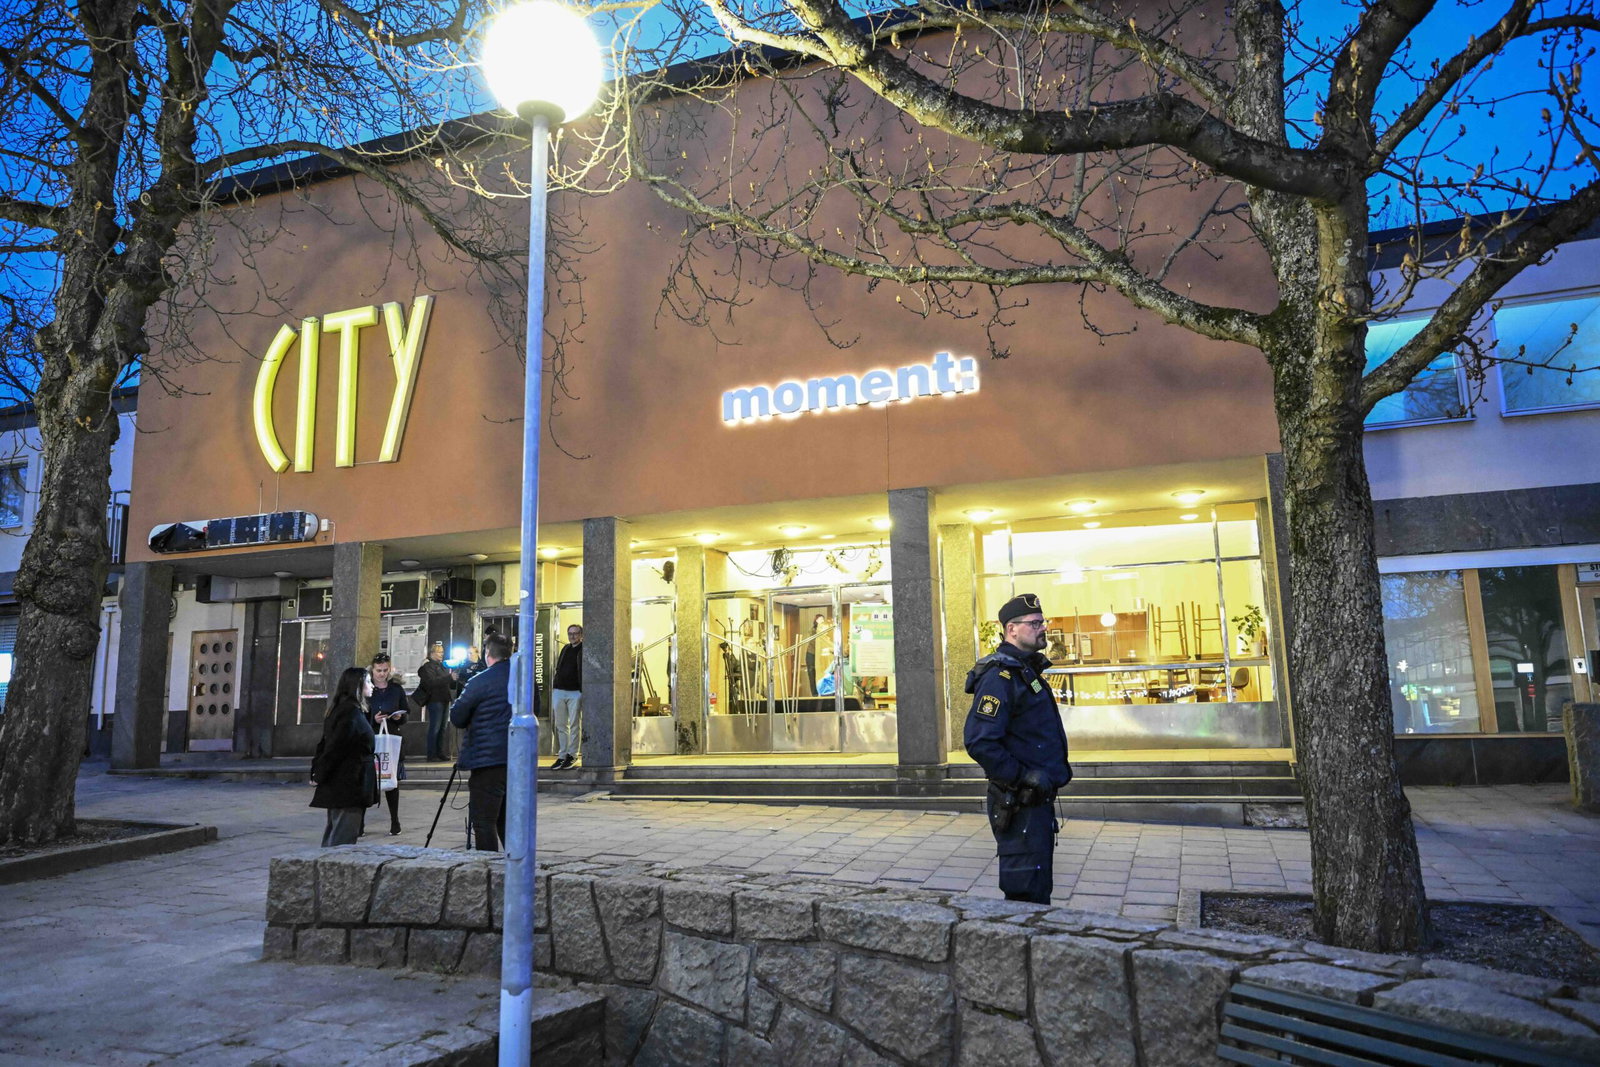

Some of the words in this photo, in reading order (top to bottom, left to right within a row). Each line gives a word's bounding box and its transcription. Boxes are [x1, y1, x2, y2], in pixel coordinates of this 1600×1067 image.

[253, 295, 432, 474] CITY
[535, 633, 544, 684] BABURCHI.NU
[982, 695, 999, 705] POLIS
